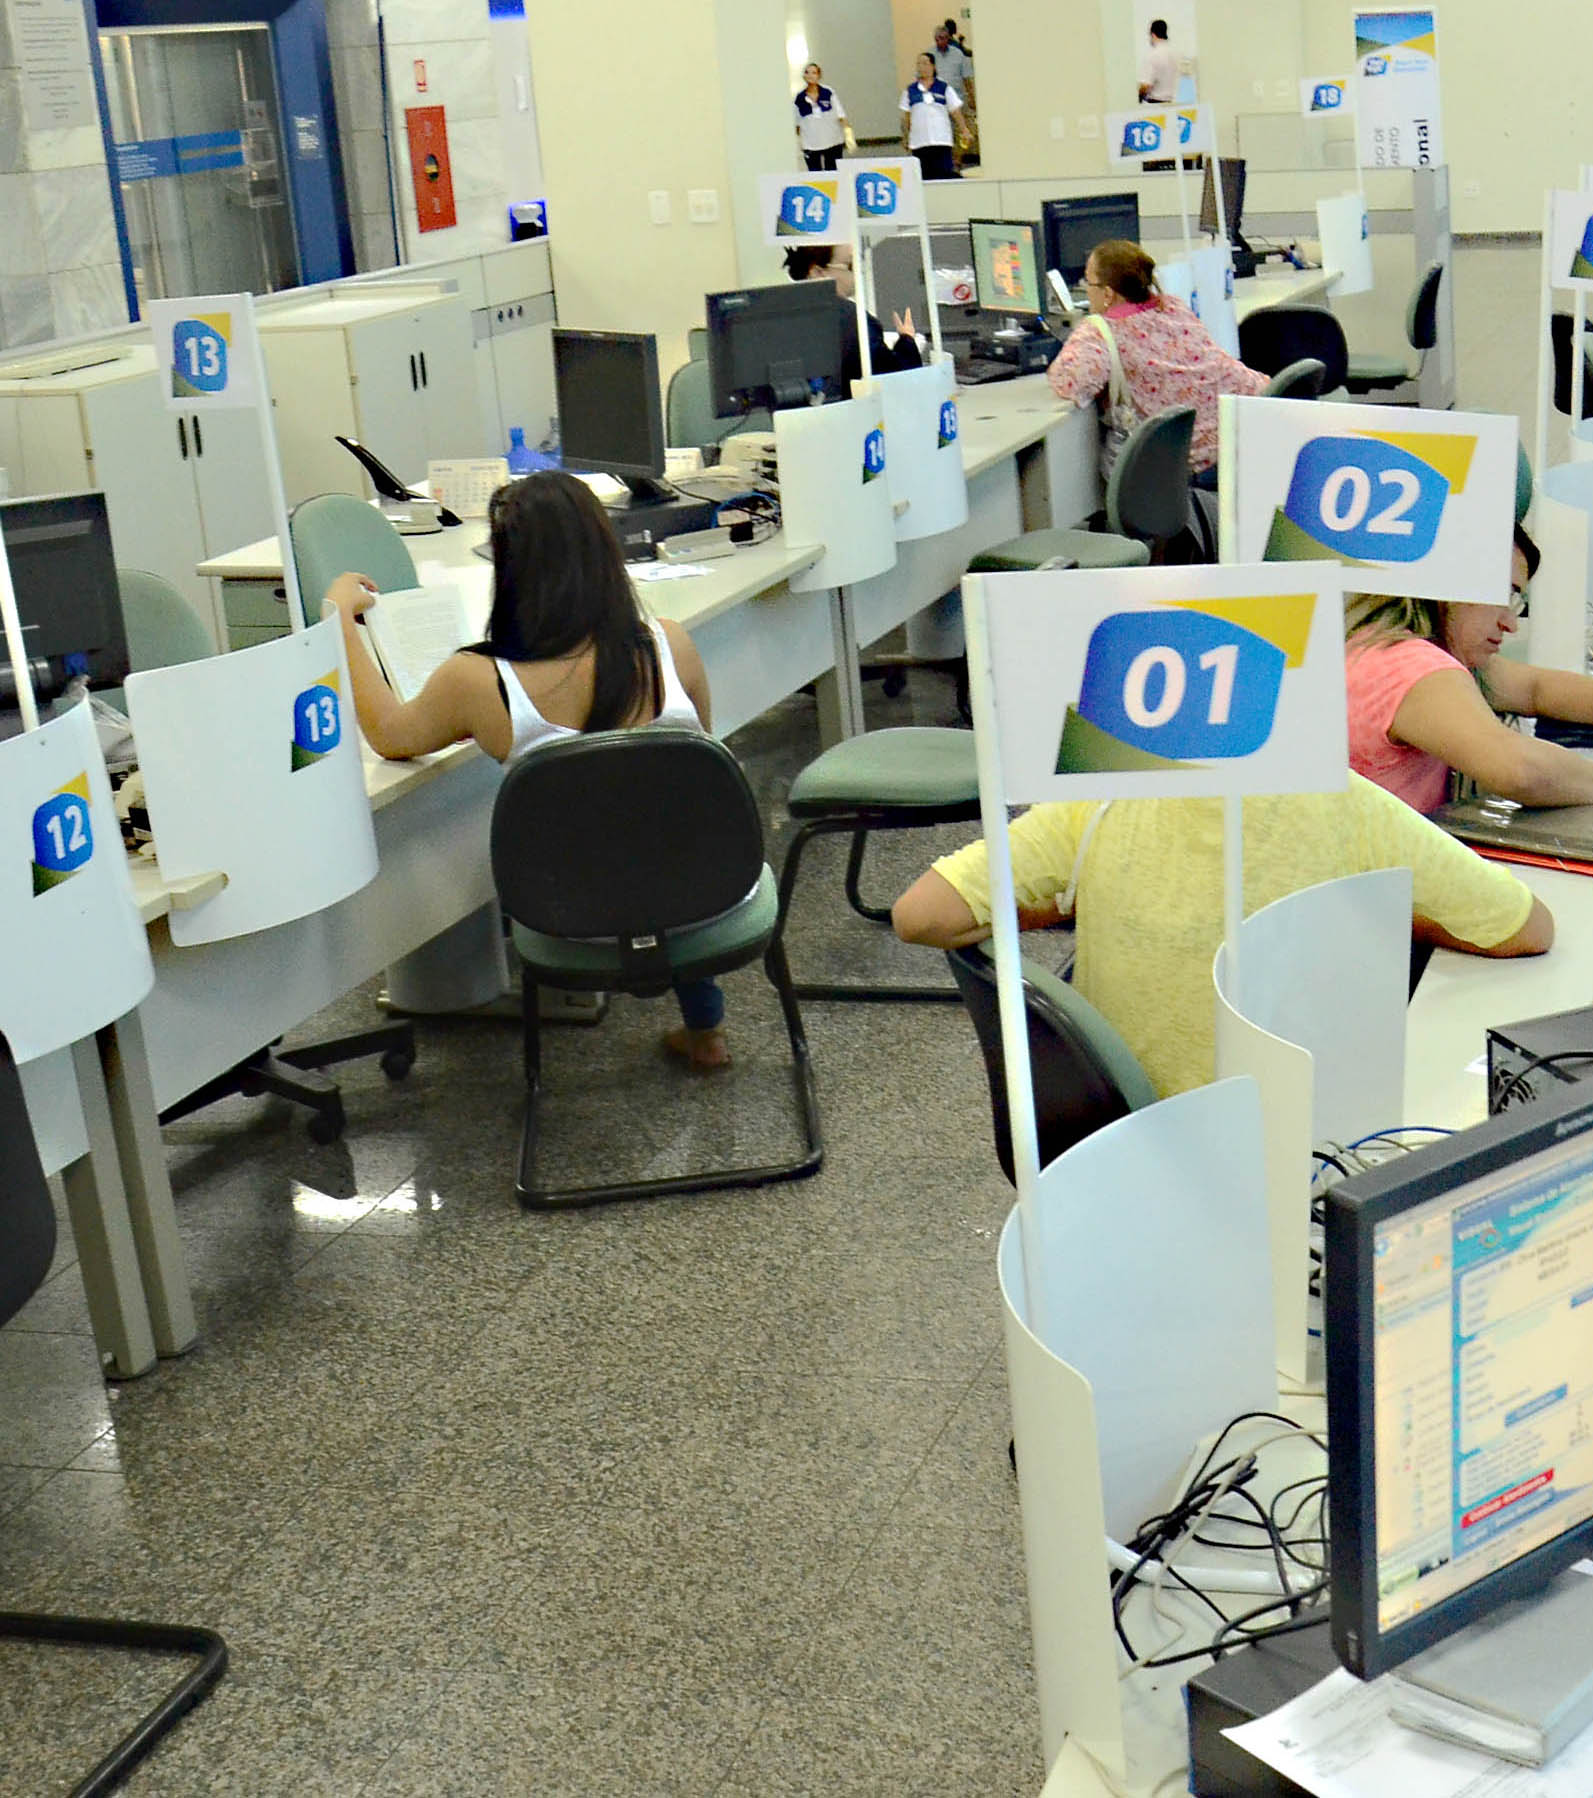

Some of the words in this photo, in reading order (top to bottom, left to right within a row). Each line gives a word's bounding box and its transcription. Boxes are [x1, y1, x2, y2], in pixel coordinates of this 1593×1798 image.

[1131, 125, 1157, 148] 16
[792, 195, 824, 223] 14
[863, 181, 891, 207] 15
[184, 335, 220, 377] 13
[1319, 465, 1421, 536] 02
[1123, 644, 1239, 728] 01
[305, 696, 337, 743] 13
[46, 804, 86, 860] 12
